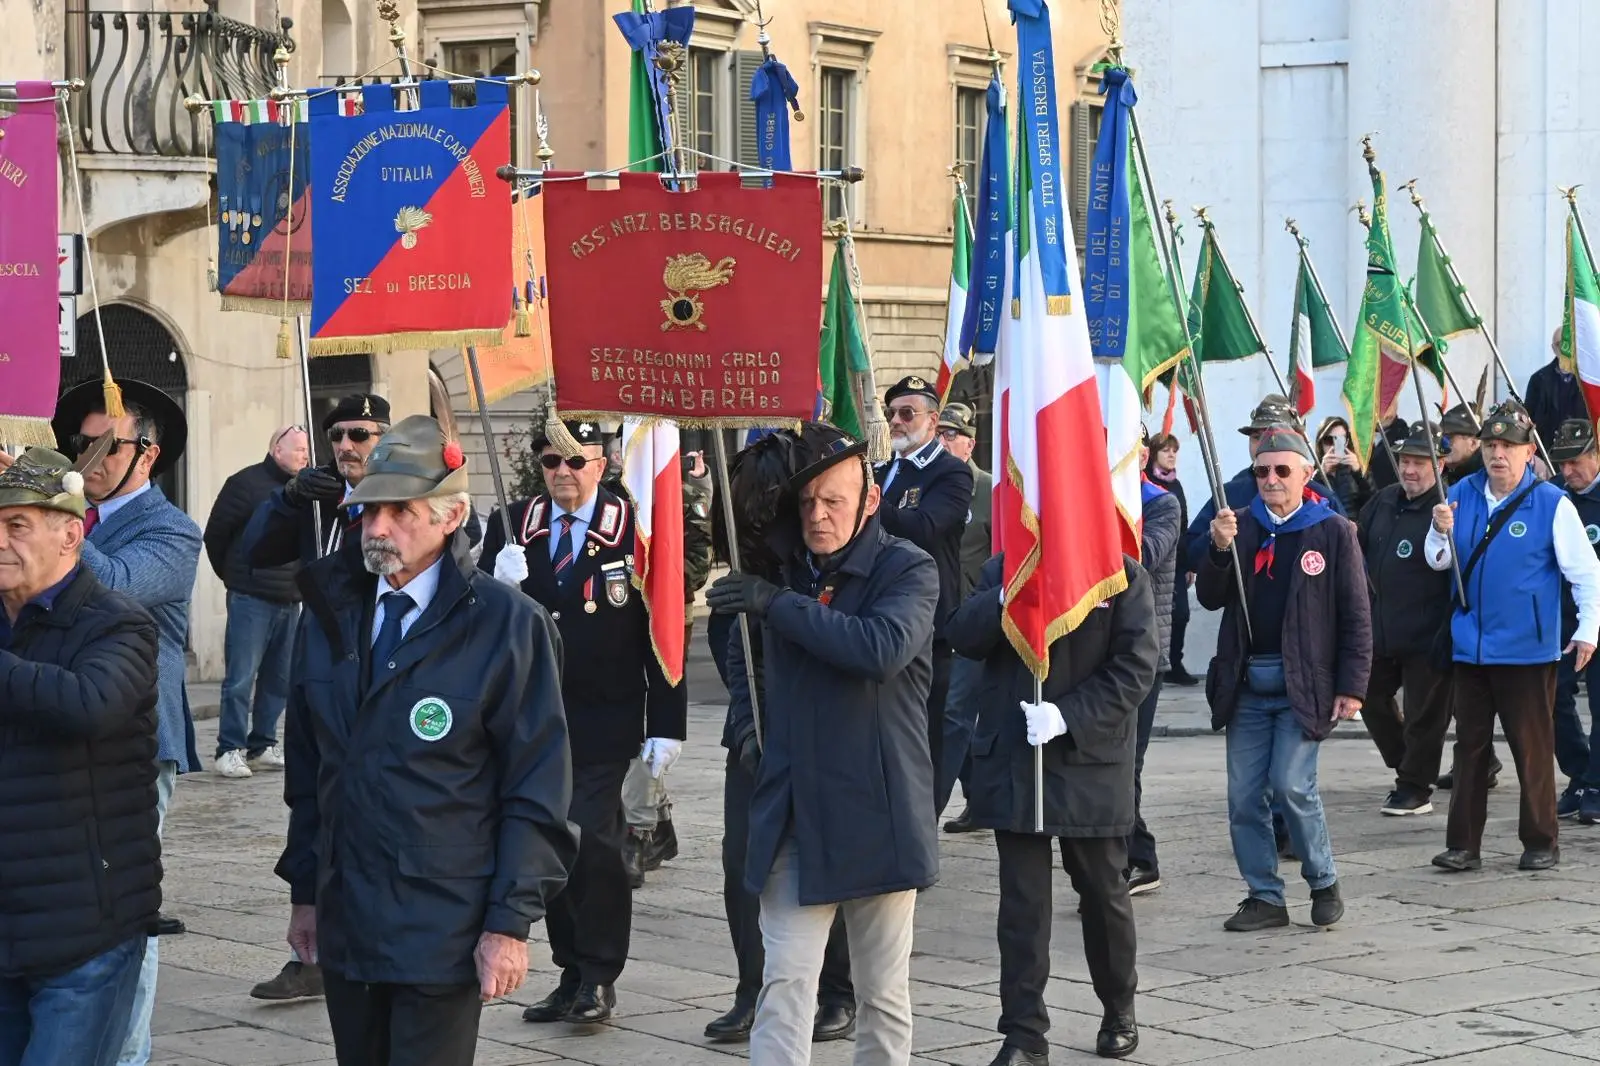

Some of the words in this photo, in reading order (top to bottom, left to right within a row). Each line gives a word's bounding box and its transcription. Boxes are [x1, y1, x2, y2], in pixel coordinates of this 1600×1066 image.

[1033, 49, 1049, 116] BRESCIA
[1035, 122, 1051, 166] SPERI
[331, 131, 382, 202] ASSOCIAZIONE
[378, 123, 446, 143] NAZIONALE
[443, 134, 486, 198] CARABINIERI
[381, 164, 433, 182] D'ITALIA
[1040, 171, 1053, 208] TITO
[1093, 163, 1111, 210] FANTE
[659, 212, 801, 262] BERSAGLIERI
[1045, 214, 1056, 245] SEZ.
[1092, 226, 1107, 256] DEL
[1110, 216, 1121, 267] BIONE
[343, 277, 376, 294] SEZ.
[386, 282, 399, 293] DI
[408, 272, 472, 292] BRESCIA
[986, 275, 998, 289] di
[1108, 283, 1121, 299] DI
[983, 297, 996, 332] SEZ.
[721, 351, 781, 369] CARLO
[591, 366, 705, 387] BARCELLARI
[723, 370, 781, 386] GUIDO
[618, 384, 756, 410] GAMBARA
